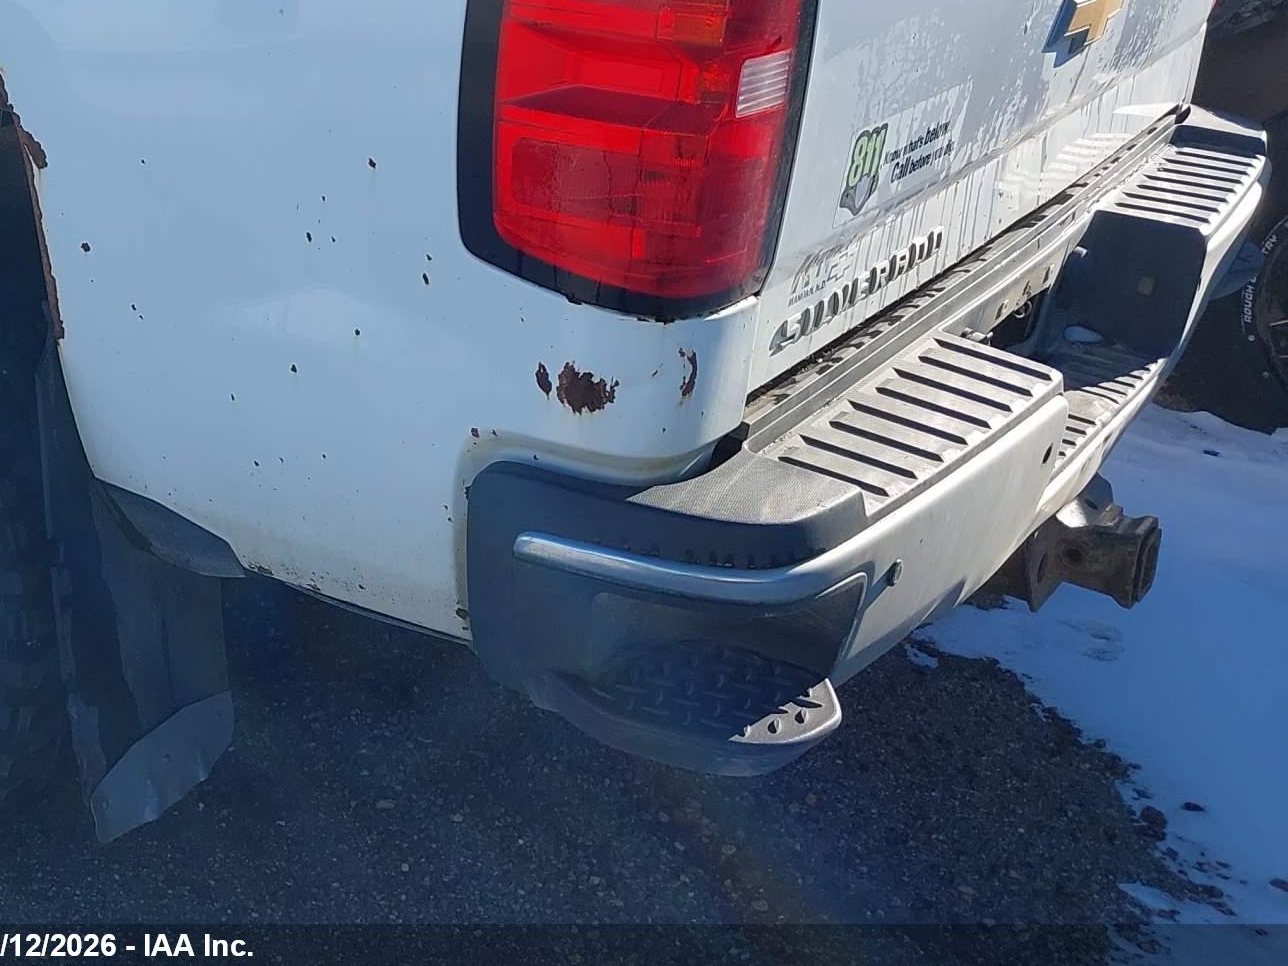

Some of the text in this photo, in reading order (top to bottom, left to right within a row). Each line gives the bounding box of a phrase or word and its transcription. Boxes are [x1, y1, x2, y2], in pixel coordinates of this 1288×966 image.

[846, 123, 888, 187] 811
[890, 155, 912, 183] Call
[908, 152, 932, 175] before
[1243, 283, 1256, 323] ROUGH
